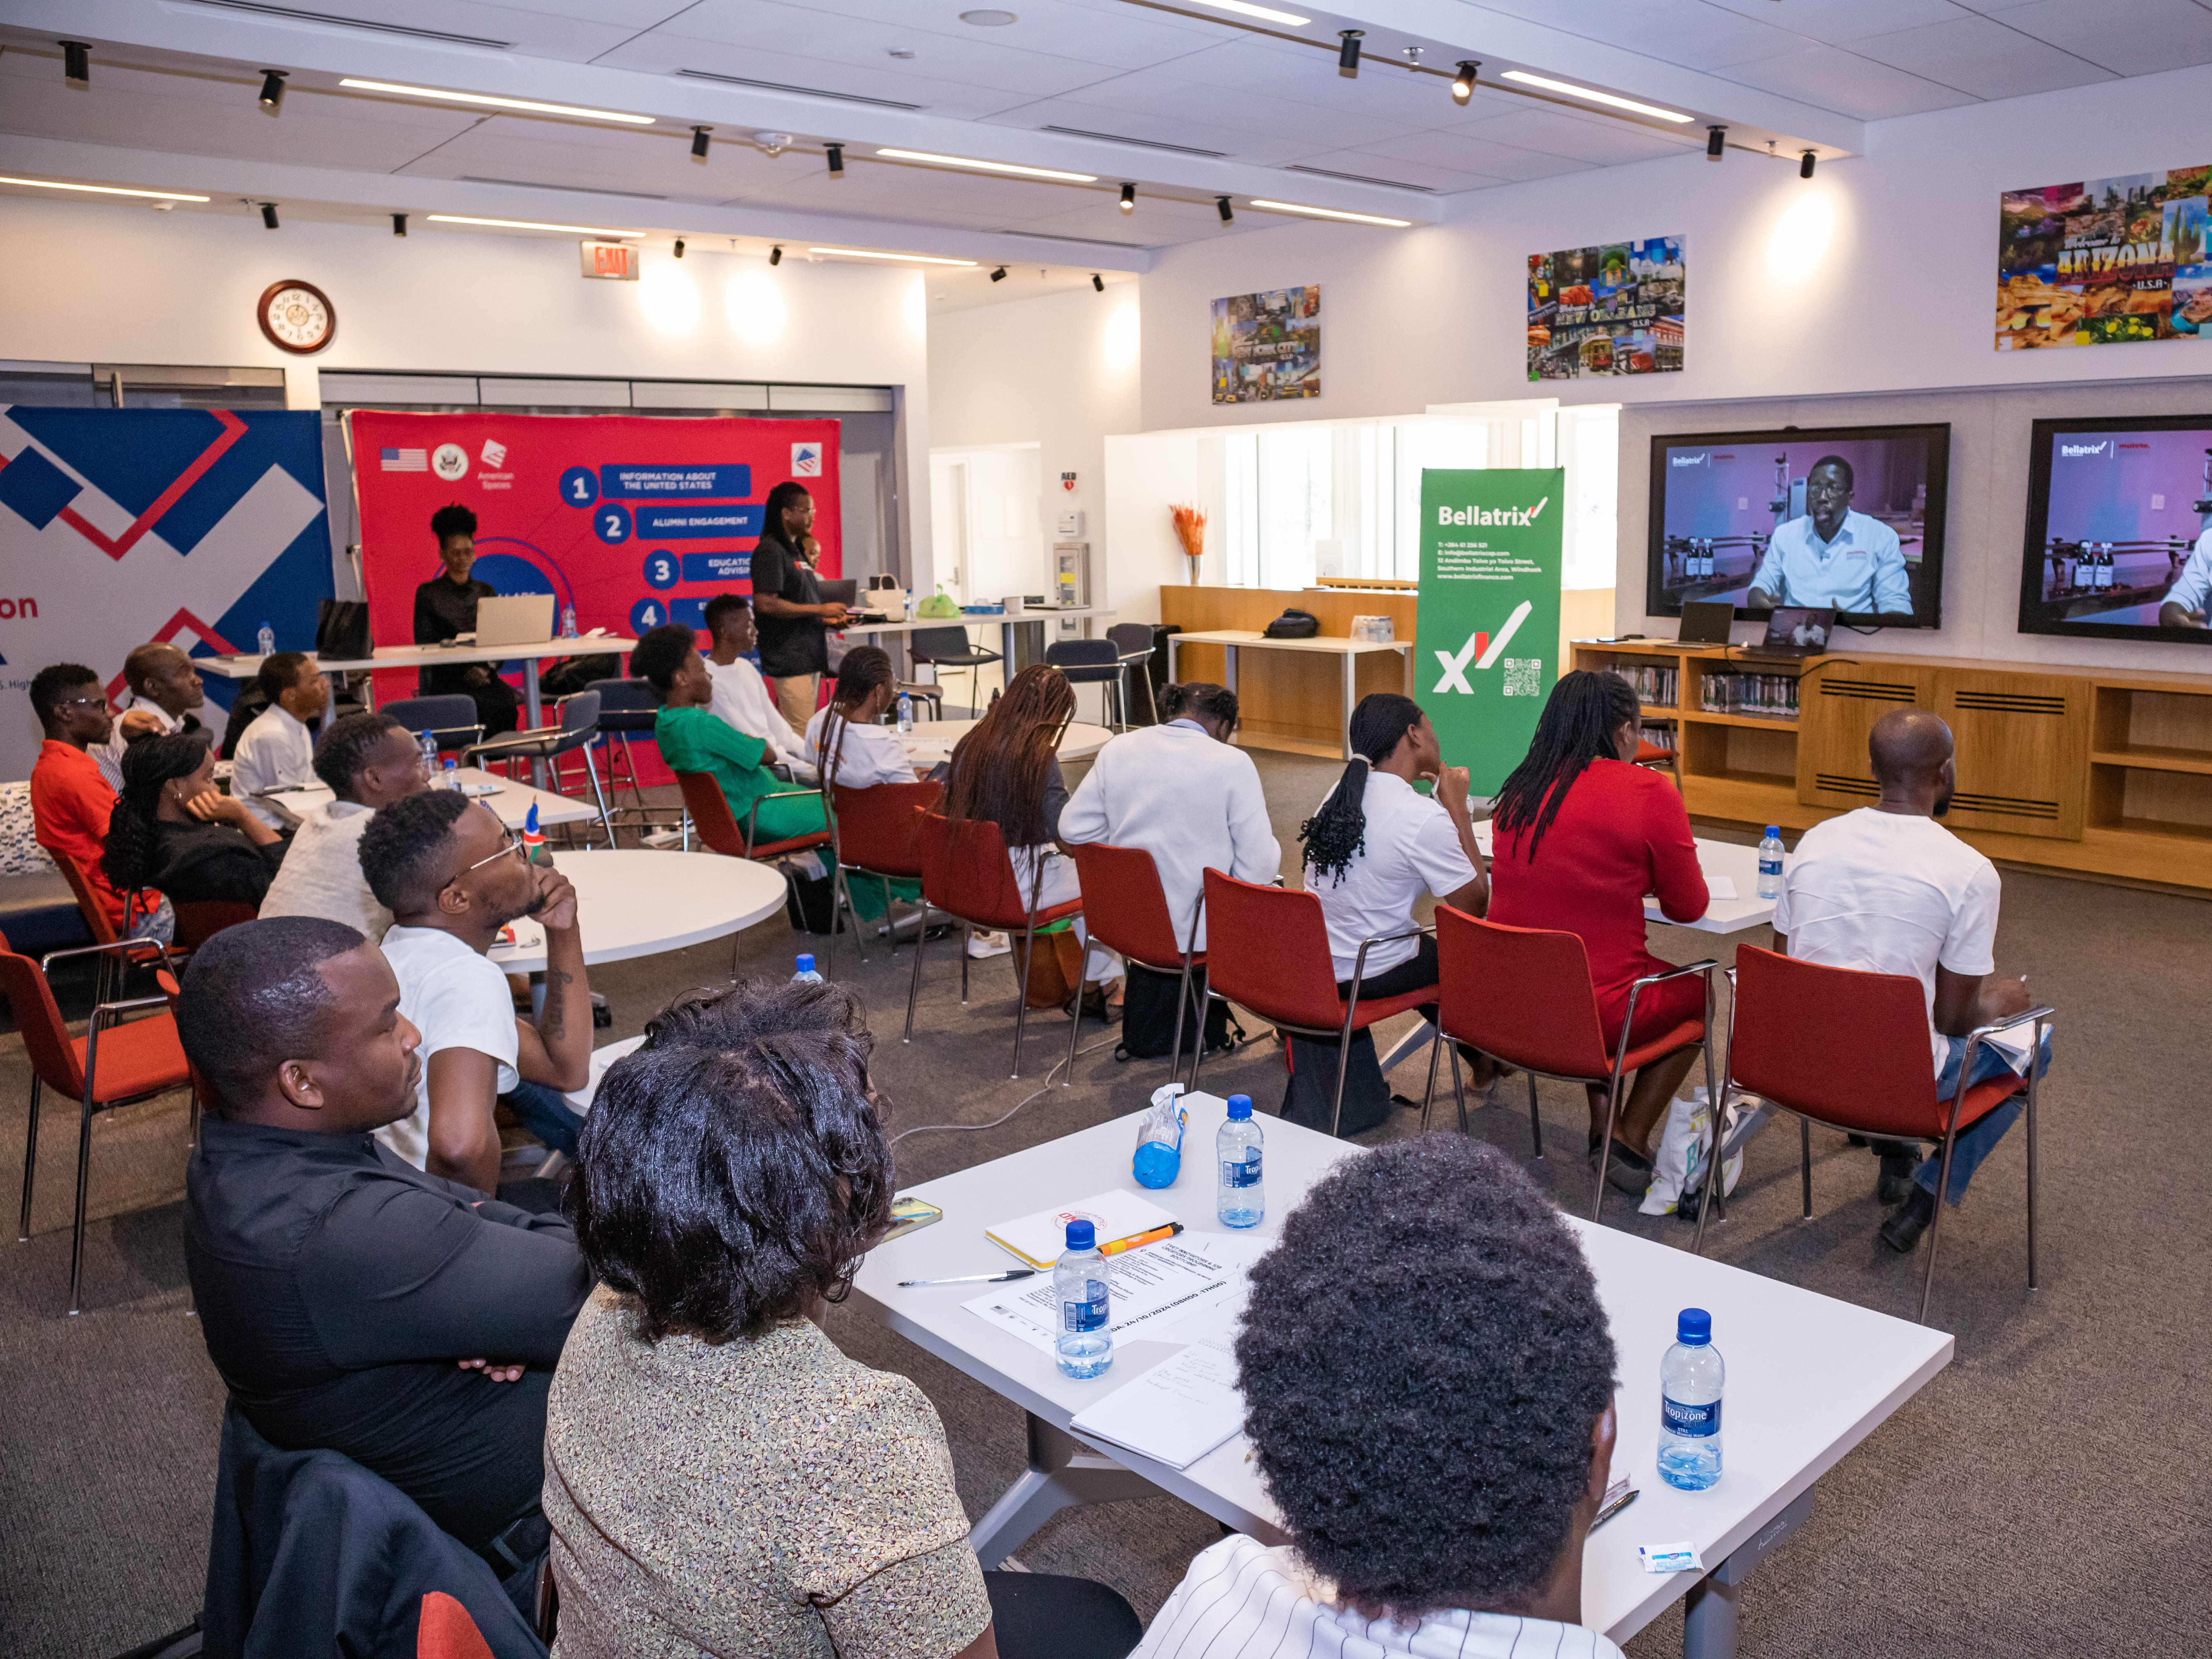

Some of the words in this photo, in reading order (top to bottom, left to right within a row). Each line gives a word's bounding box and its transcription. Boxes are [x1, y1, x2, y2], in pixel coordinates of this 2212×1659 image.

[595, 247, 628, 275] EXIT
[2055, 241, 2175, 285] ARIZONA
[1591, 304, 1656, 322] ORLEANS
[2061, 440, 2107, 454] Bellatrix
[1672, 452, 1705, 465] Bellatrix
[620, 472, 684, 481] INFORMATION
[686, 472, 716, 481] ABOUT
[624, 482, 641, 490] THE
[644, 482, 677, 490] UNITED
[679, 481, 712, 489] STATES
[573, 477, 589, 499] 1
[1438, 496, 1548, 526] Bellatrix
[606, 515, 622, 537] 2
[652, 518, 687, 527] ALUMNI
[689, 516, 748, 526] ENGAGEMENT
[655, 560, 670, 581] 3
[641, 605, 657, 627] 4
[1170, 1293, 1198, 1307] (08H00
[1200, 1281, 1227, 1294] -17H00)
[1664, 1400, 1707, 1420] Tropizone
[1684, 1420, 1706, 1429] AQUA
